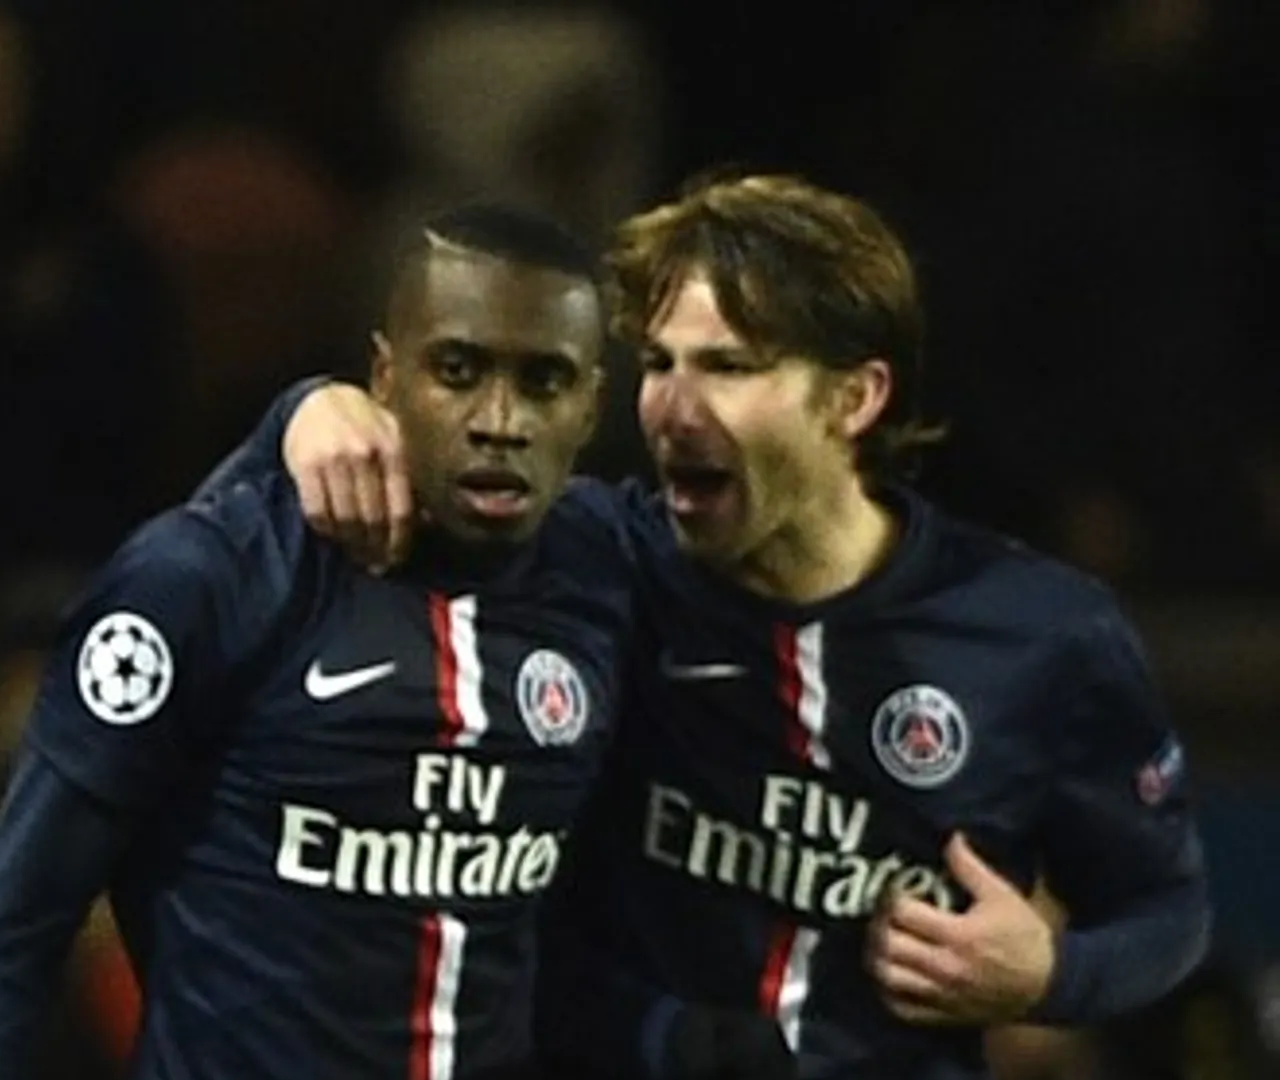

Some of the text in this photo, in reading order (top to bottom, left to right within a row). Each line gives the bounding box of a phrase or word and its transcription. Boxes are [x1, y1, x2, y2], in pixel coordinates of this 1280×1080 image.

[413, 754, 505, 825] Fly
[761, 773, 870, 854] Fly
[276, 803, 560, 897] Emirate
